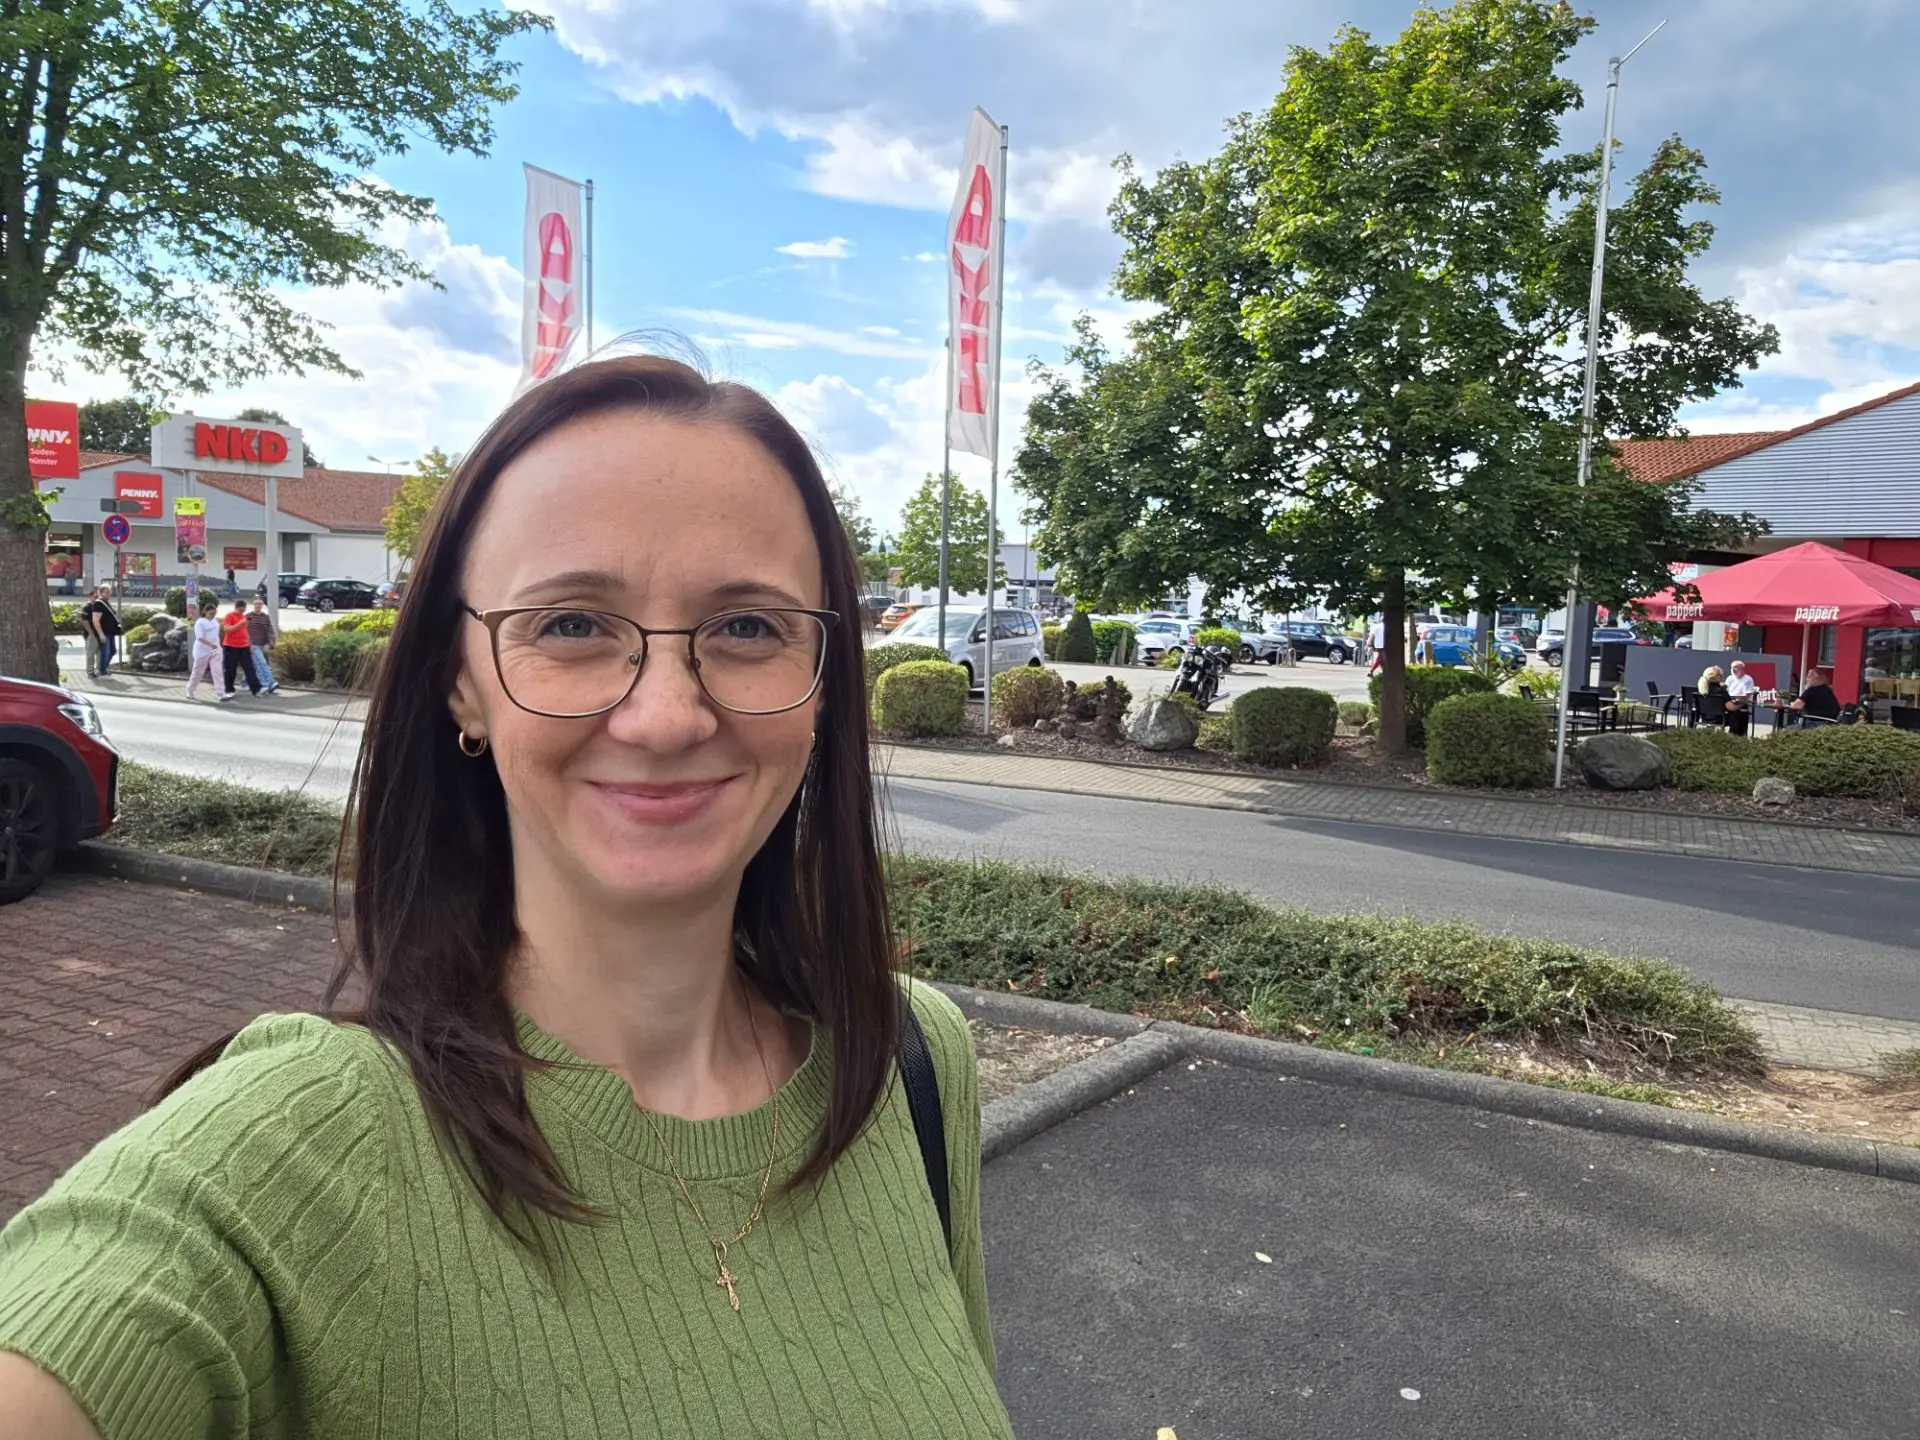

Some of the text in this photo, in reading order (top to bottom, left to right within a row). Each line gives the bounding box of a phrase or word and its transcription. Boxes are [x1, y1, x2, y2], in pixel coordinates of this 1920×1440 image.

[27, 427, 71, 445] NNY.
[194, 422, 289, 464] NKD
[1665, 602, 1704, 620] pappert
[1794, 606, 1840, 623] pappert
